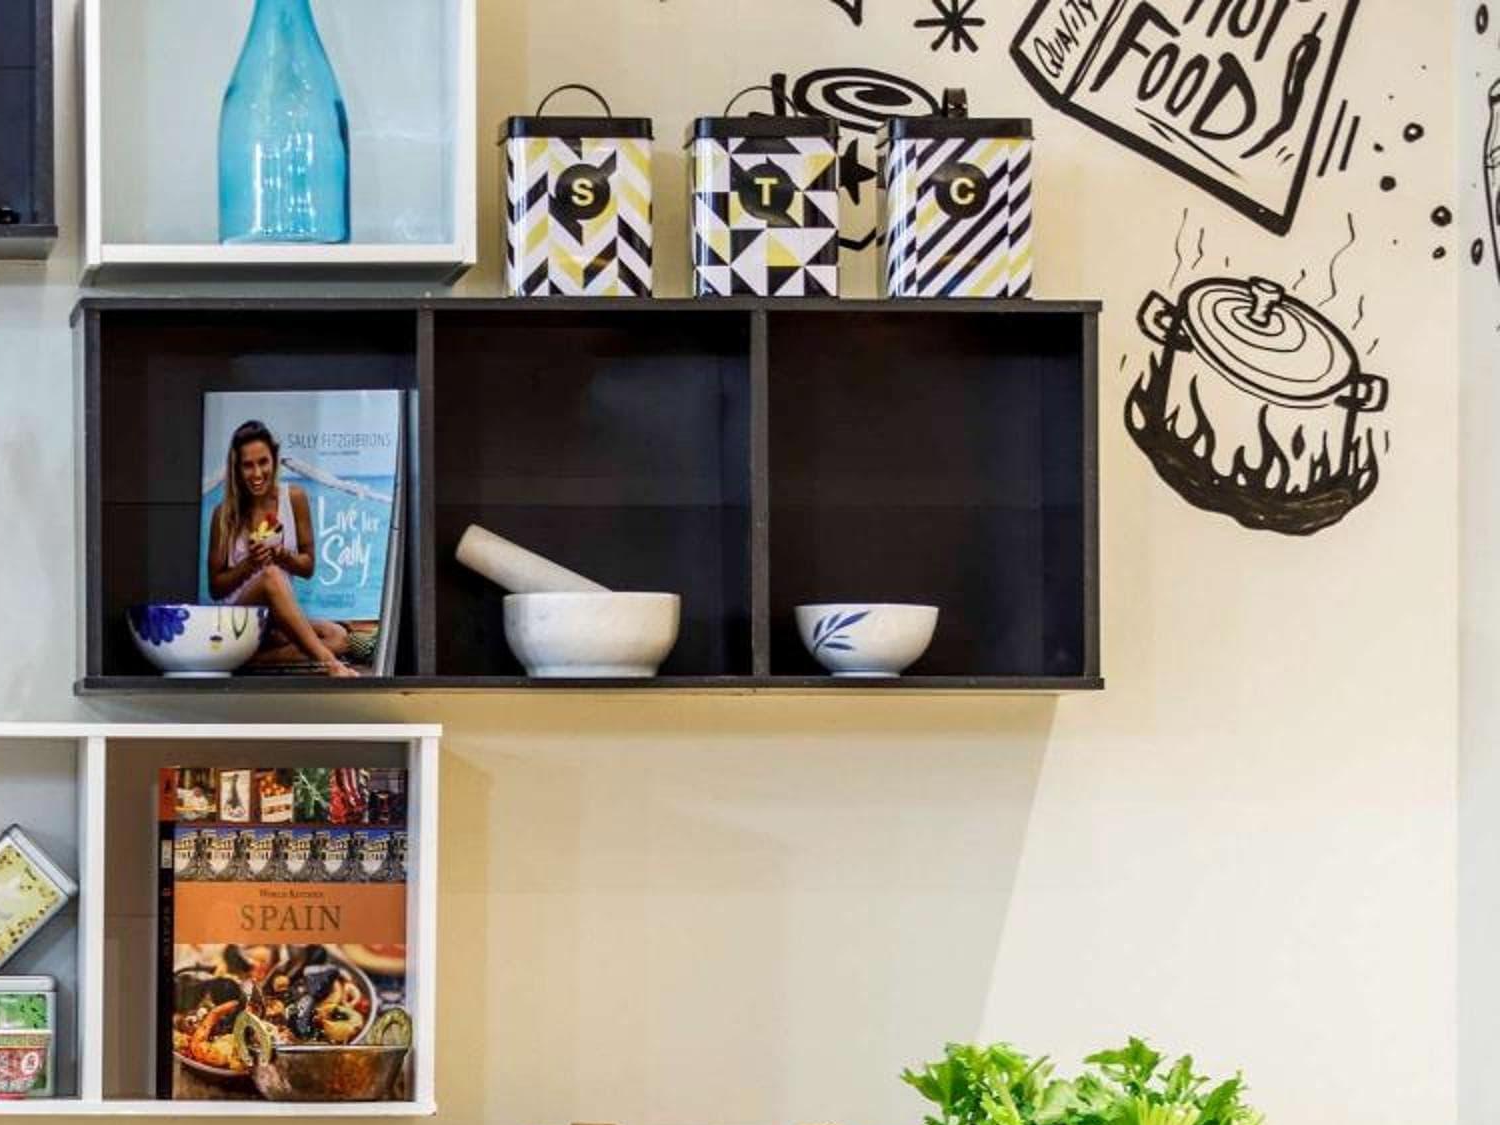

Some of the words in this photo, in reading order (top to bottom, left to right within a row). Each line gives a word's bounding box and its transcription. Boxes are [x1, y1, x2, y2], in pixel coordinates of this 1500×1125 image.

[1089, 1, 1257, 140] FOOD
[571, 177, 595, 207] S
[753, 176, 779, 207] T
[949, 176, 976, 206] C
[287, 432, 318, 449] SALLY
[319, 533, 372, 589] Sally
[240, 904, 342, 932] SPAIN
